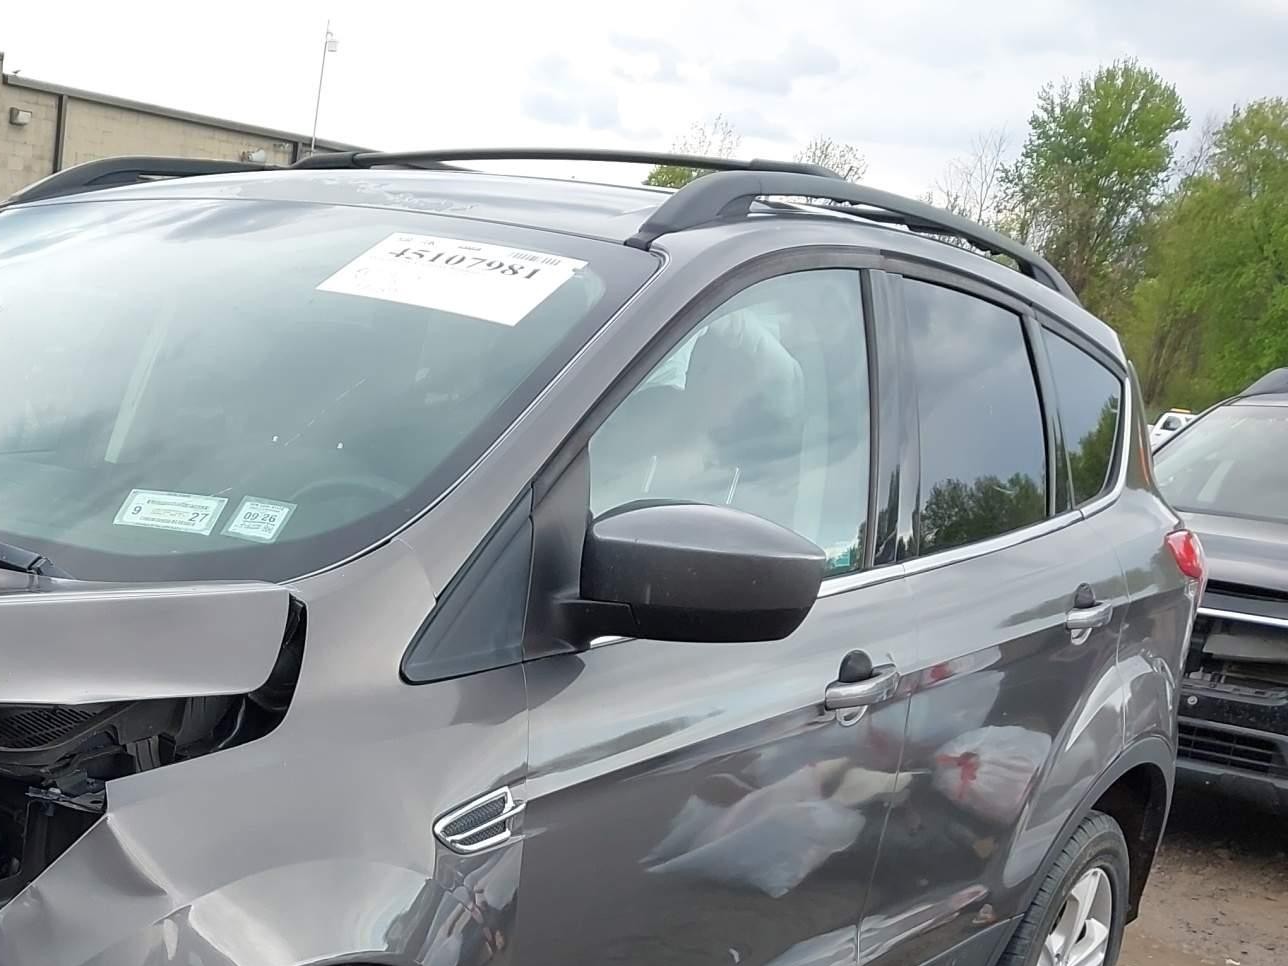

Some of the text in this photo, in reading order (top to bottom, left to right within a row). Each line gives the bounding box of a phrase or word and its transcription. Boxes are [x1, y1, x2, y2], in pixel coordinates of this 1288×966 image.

[387, 247, 541, 280] 45107981
[131, 505, 143, 516] 9
[188, 512, 210, 524] 27
